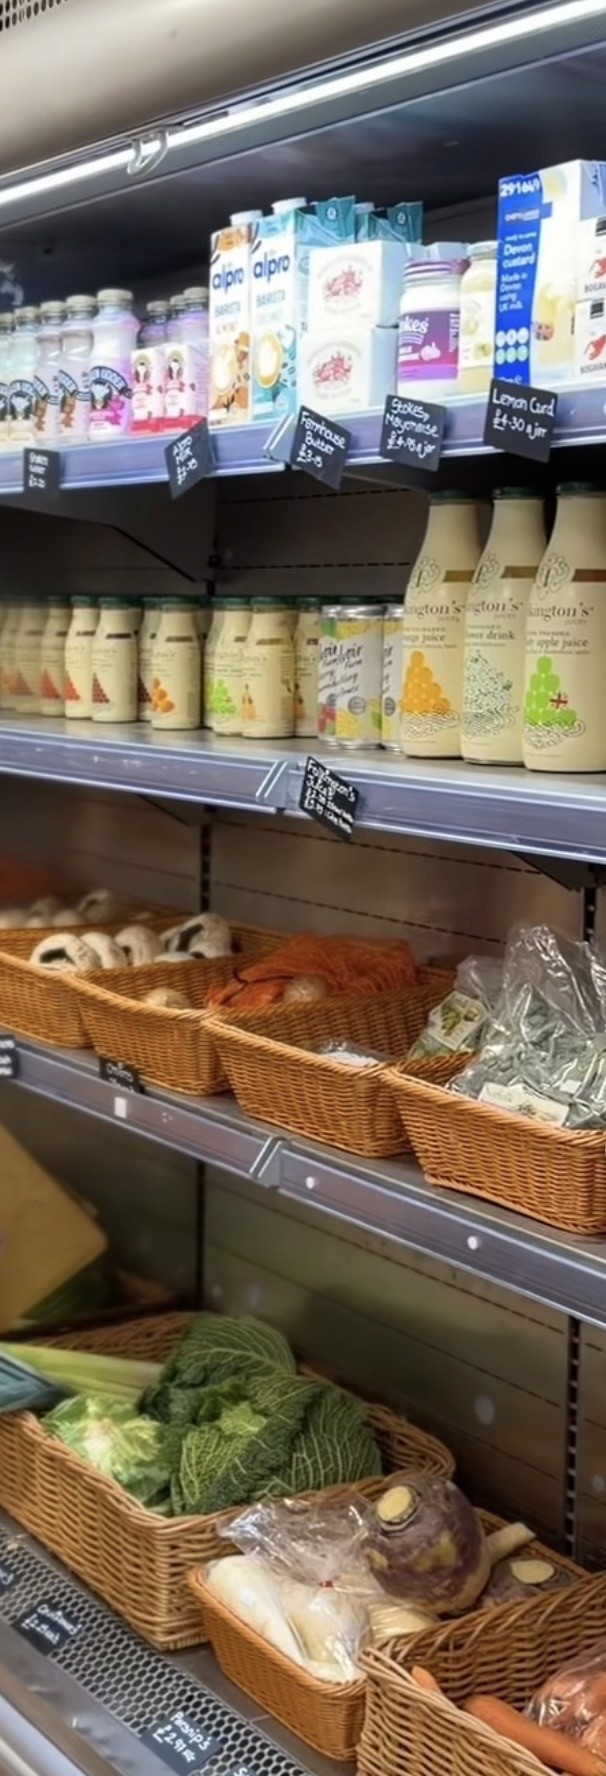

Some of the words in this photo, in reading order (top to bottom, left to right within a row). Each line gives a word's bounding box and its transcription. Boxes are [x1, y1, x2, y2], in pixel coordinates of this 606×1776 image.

[503, 242, 533, 256] Devon
[253, 252, 290, 283] alpro
[502, 252, 536, 269] custard
[212, 265, 244, 295] alpro
[492, 387, 528, 411] Lemon
[529, 397, 556, 417] Curd
[301, 411, 346, 450] Farmhouse
[305, 430, 335, 455] Butter
[421, 633, 446, 644] juice
[486, 629, 515, 639] drink
[561, 638, 588, 650] juice
